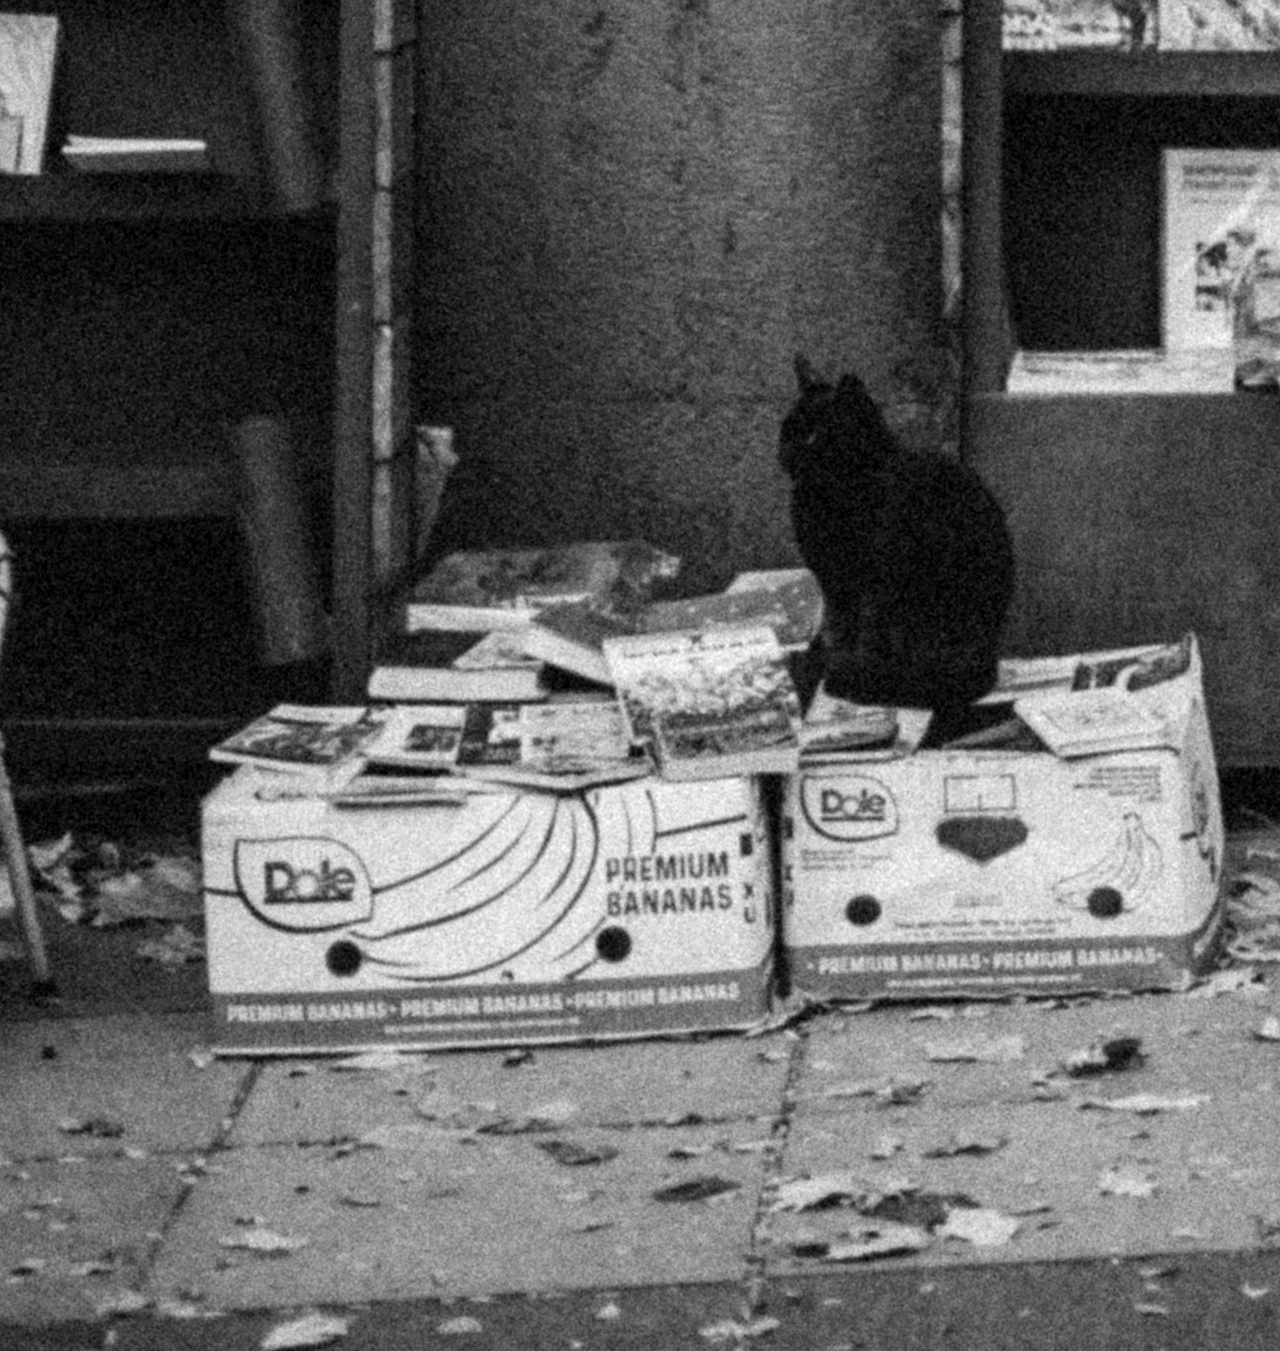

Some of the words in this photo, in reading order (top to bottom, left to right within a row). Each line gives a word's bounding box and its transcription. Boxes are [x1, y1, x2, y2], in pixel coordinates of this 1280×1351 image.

[821, 788, 887, 815] Dole
[264, 858, 356, 901] Dole
[606, 850, 729, 883] PREMIUM
[606, 884, 733, 917] BANANAS
[818, 955, 899, 974] PREMIUM
[901, 952, 981, 972] BANANAS
[992, 949, 1073, 969] PREMIUM
[1076, 947, 1156, 966] BANANAS
[226, 1002, 305, 1023] PREMIUM
[307, 1000, 387, 1021] BANANAS
[400, 996, 480, 1017] PREMIUM
[482, 992, 564, 1014] BANANAS
[574, 987, 655, 1010] PREMIUM
[657, 981, 740, 1005] BANANAS
